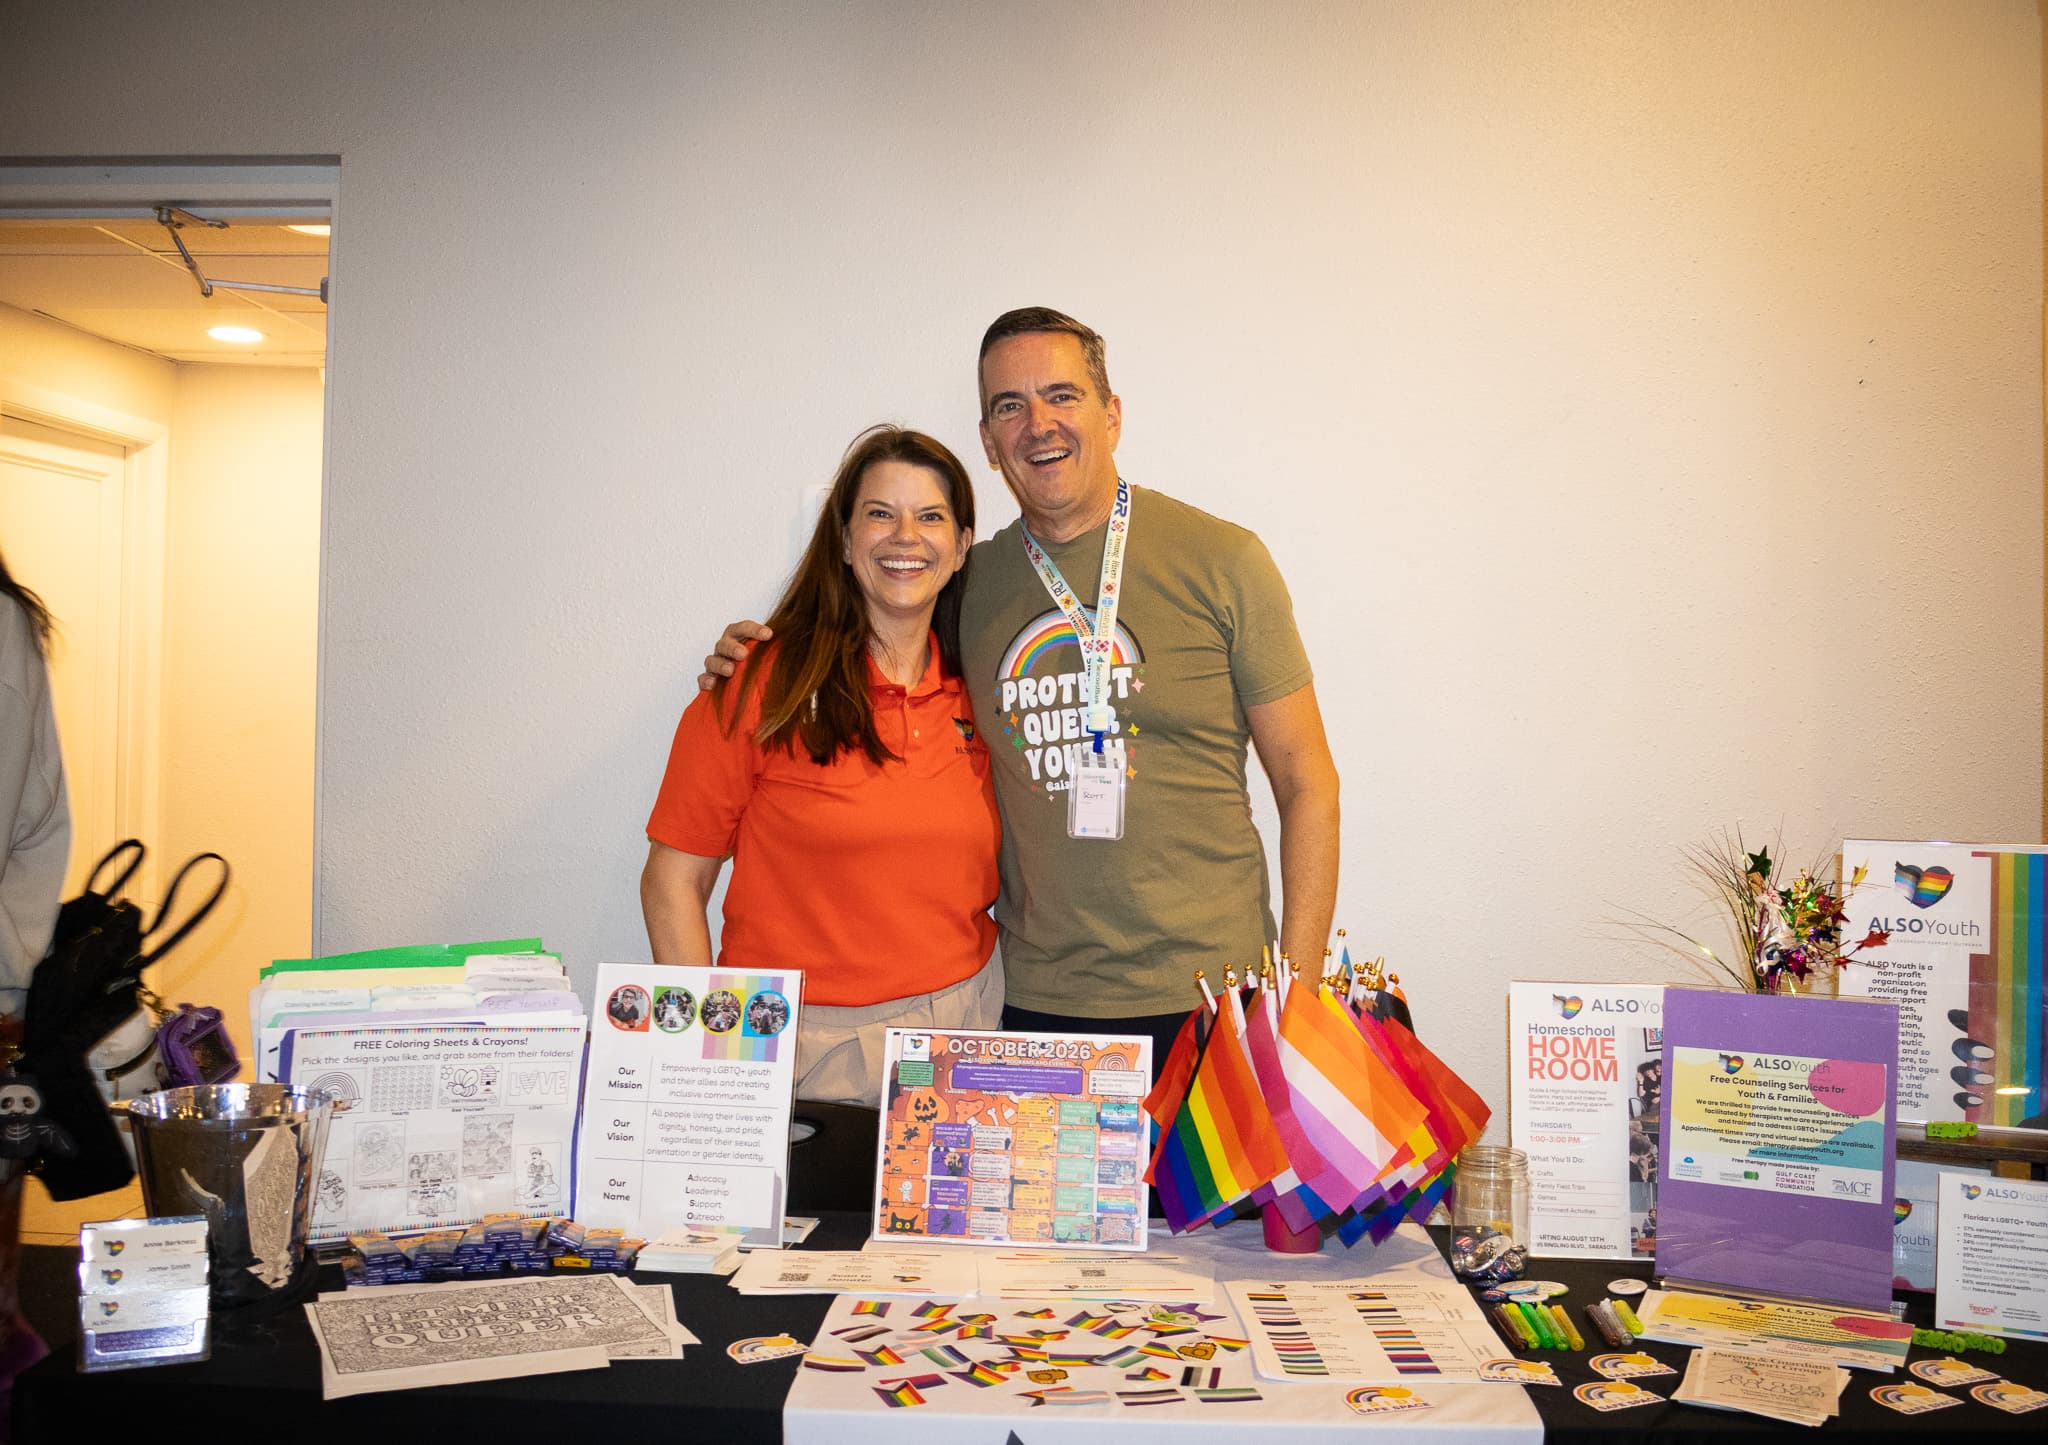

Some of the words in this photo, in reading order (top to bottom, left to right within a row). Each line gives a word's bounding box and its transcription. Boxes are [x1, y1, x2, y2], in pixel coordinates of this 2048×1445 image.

[1002, 667, 1132, 712] PROTET
[1891, 961, 1916, 970] Youth
[1872, 978, 1926, 987] organization
[1868, 987, 1908, 995] providing
[1911, 988, 1927, 996] free
[1528, 1023, 1615, 1037] Homeschool
[354, 1041, 381, 1049] FREE
[386, 1039, 430, 1049] Coloring
[433, 1038, 468, 1046] Sheets
[483, 1037, 528, 1047] Crayons!
[948, 1038, 1040, 1058] OCTOBER
[1044, 1044, 1091, 1059] 2026
[1528, 1035, 1616, 1059] HOME
[302, 1057, 321, 1065] Pick
[325, 1056, 340, 1064] the
[343, 1056, 379, 1065] designs
[382, 1055, 400, 1063] you
[422, 1052, 440, 1060] and
[443, 1052, 464, 1061] grab
[494, 1050, 515, 1058] from
[518, 1050, 538, 1058] their
[541, 1050, 573, 1058] folders!
[618, 1067, 635, 1075] Our
[661, 1064, 711, 1075] Empowering
[713, 1066, 745, 1076] LGBTQ+
[748, 1068, 771, 1077] youth
[1528, 1057, 1618, 1082] ROOM
[1919, 1067, 1938, 1075] ages
[608, 1081, 642, 1089] Mission
[678, 1077, 695, 1085] their
[720, 1079, 735, 1087] and
[737, 1080, 770, 1090] creating
[1710, 1075, 1730, 1083] Free
[1732, 1077, 1786, 1090] Counseling
[1789, 1082, 1829, 1092] Services
[669, 1090, 701, 1098] inclusive
[1738, 1090, 1766, 1099] Youth
[1768, 1092, 1775, 1100] &
[1777, 1094, 1818, 1104] Families
[652, 1109, 663, 1117] All
[664, 1111, 691, 1119] people
[693, 1111, 713, 1121] living
[715, 1112, 733, 1120] their
[736, 1113, 753, 1121] lives
[755, 1114, 773, 1122] with
[1752, 1104, 1777, 1112] provide
[1793, 1108, 1830, 1117] counseling
[1705, 1108, 1738, 1116] facilitated
[1749, 1112, 1782, 1120] therapists
[1812, 1118, 1854, 1127] experienced
[1732, 1119, 1756, 1127] trained
[613, 1119, 630, 1128] Our
[1530, 1121, 1572, 1129] THURSDAYS
[1681, 1124, 1724, 1134] Appointment
[607, 1133, 634, 1141] Vision
[661, 1136, 702, 1145] regardless
[714, 1138, 732, 1146] their
[647, 1148, 691, 1157] orientation
[703, 1151, 731, 1159] gender
[1763, 1141, 1844, 1156] therapy@alsoyouth.org
[1745, 1159, 1767, 1167] therapy
[608, 1179, 626, 1187] Our
[688, 1174, 727, 1185] Advocacy
[1776, 1177, 1815, 1185] COMMUNITY
[686, 1186, 729, 1197] Leadership
[1776, 1183, 1815, 1191] FOUNDATION
[1843, 1180, 1872, 1194] MCF
[603, 1192, 630, 1201] Name
[690, 1200, 721, 1208] Support
[687, 1212, 724, 1221] Outreach
[1963, 1213, 1995, 1222] Florida's
[1996, 1217, 2024, 1225] LGBTQ+
[2026, 1220, 2047, 1228] Youth
[370, 1312, 605, 1349] QUEER
[1713, 1351, 1755, 1361] Parents
[1771, 1358, 1831, 1370] Guardians
[1733, 1358, 1779, 1369] Support
[1782, 1365, 1821, 1374] Group
